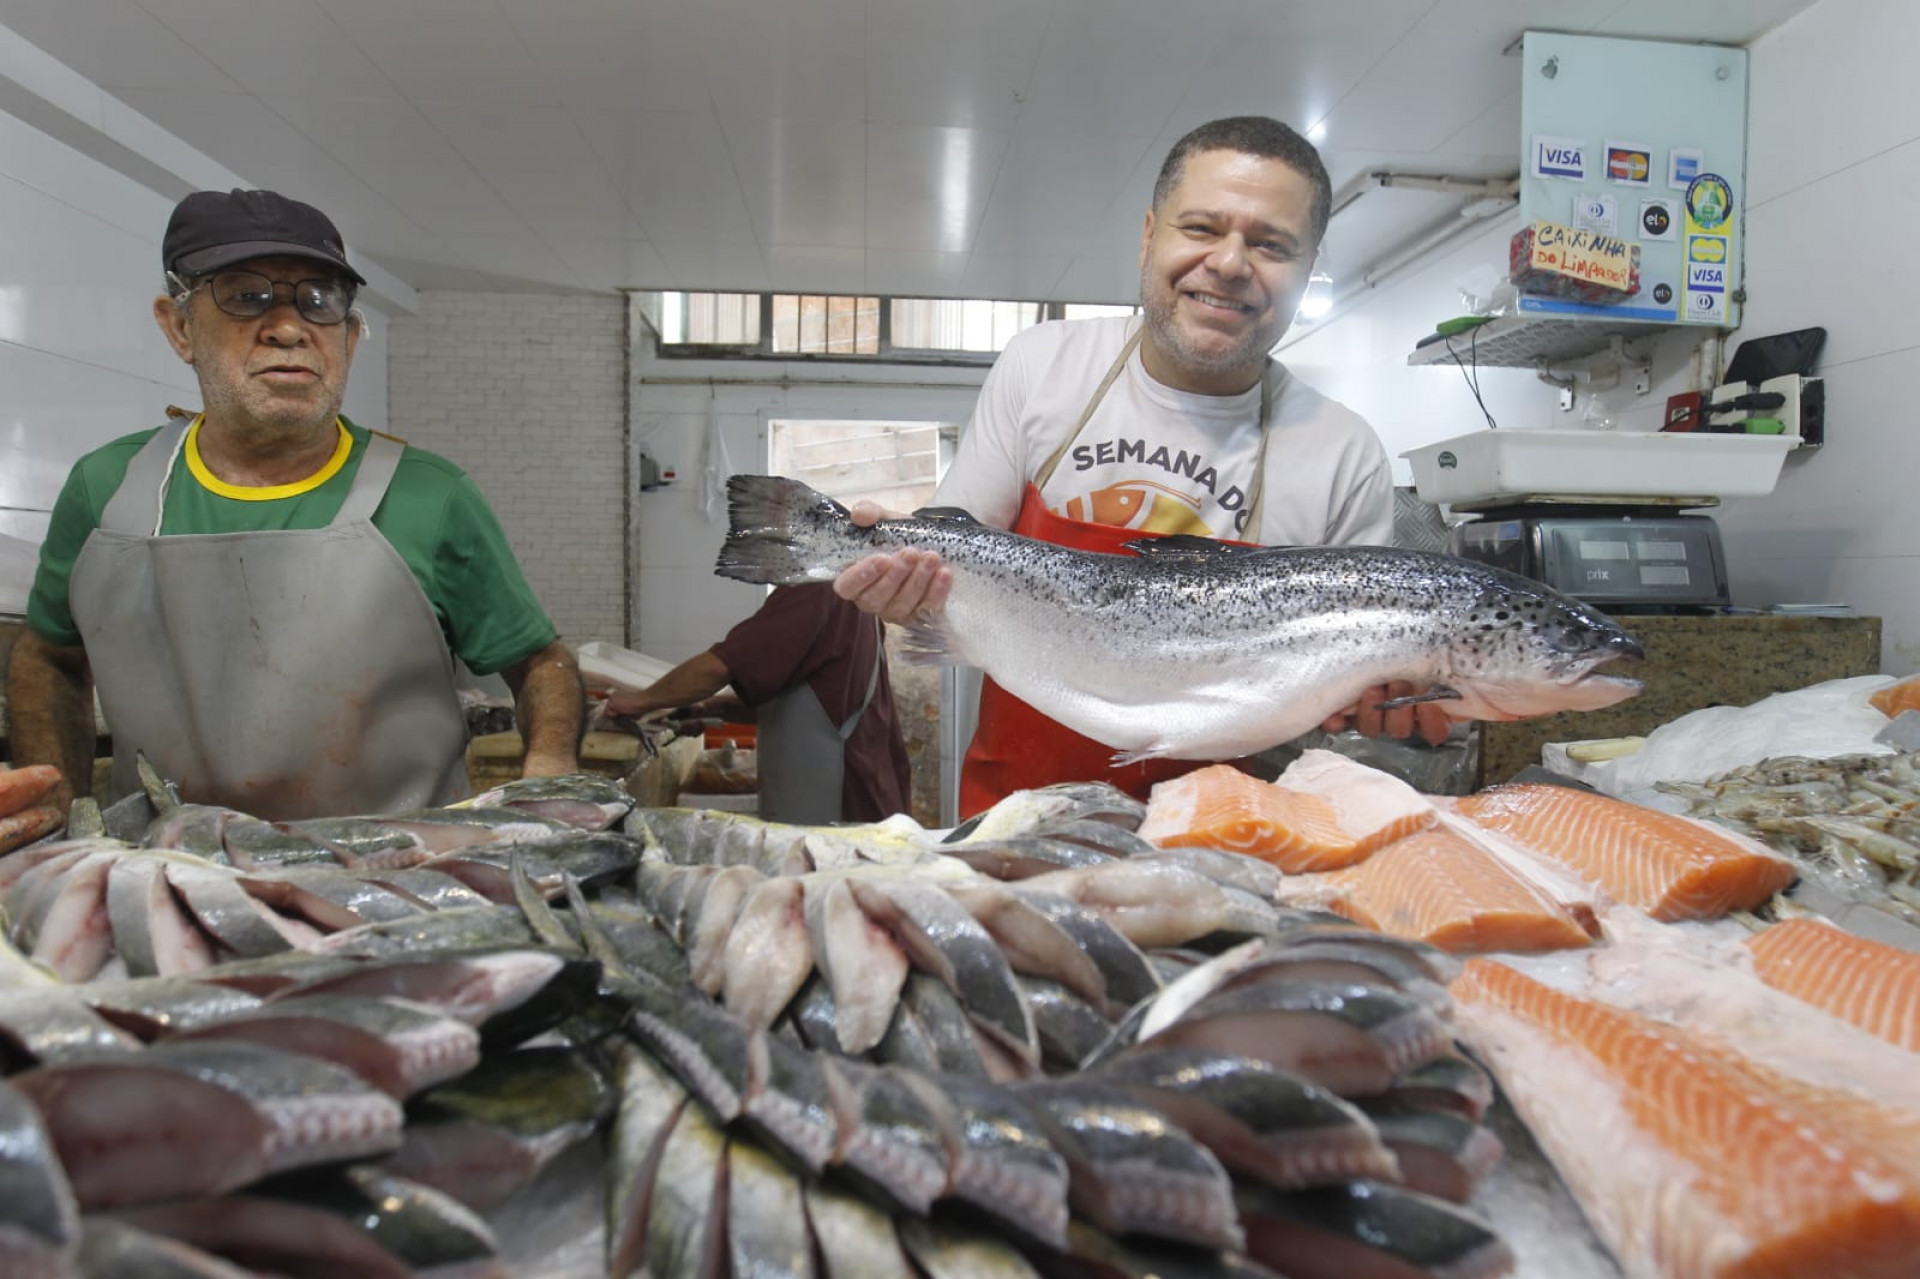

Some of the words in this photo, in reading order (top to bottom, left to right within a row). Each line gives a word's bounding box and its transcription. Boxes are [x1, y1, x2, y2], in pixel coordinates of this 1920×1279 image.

[1546, 149, 1582, 166] VISA
[1645, 213, 1668, 227] elo
[1537, 251, 1556, 264] DO
[1694, 269, 1723, 283] VISA
[1072, 438, 1218, 495] SEMANA
[1586, 568, 1610, 581] prix
